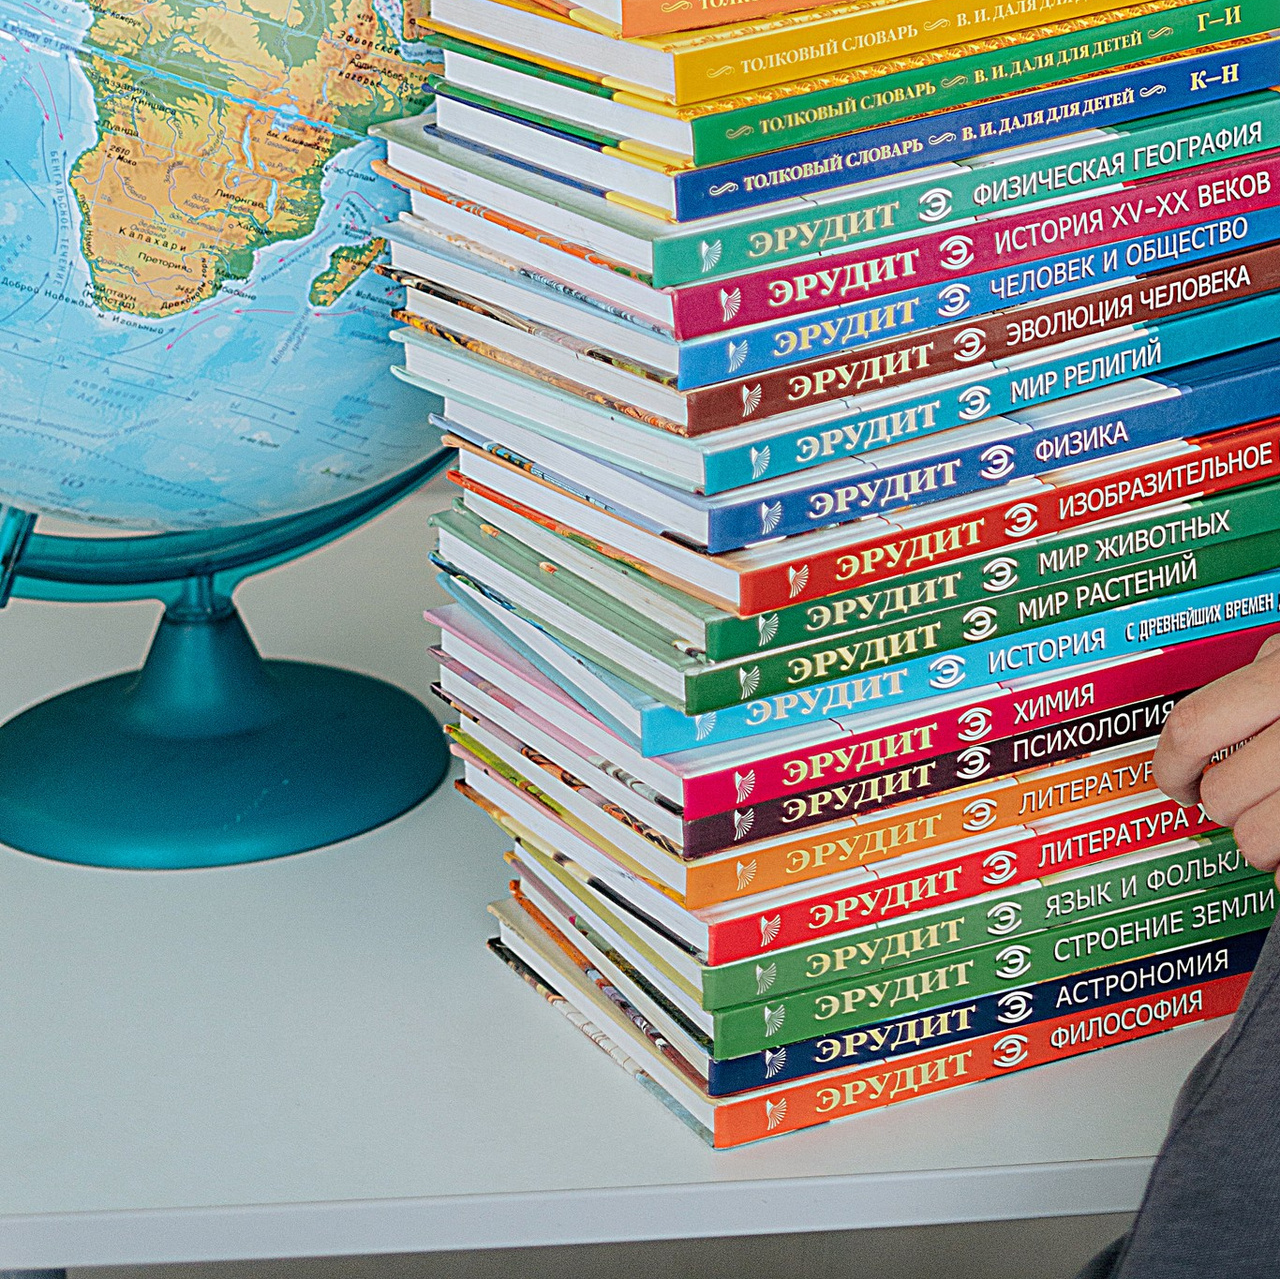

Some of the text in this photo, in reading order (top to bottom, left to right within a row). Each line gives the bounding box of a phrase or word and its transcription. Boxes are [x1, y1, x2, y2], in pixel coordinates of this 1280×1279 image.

[338, 71, 381, 88] нагорье
[741, 38, 838, 74] ТОЛКОВЫЙ
[841, 25, 918, 52] СЛОВАРЬ
[759, 97, 857, 134] ТОЛКОВЫЙ
[860, 81, 937, 110] СЛОВАРЬ
[1011, 54, 1055, 78] ДАЛЯ
[1057, 46, 1090, 66] ДЛЯ
[1092, 31, 1143, 58] ДЕТЕЙ
[102, 119, 139, 137] Луанда
[130, 94, 177, 116] Киншаса
[743, 155, 843, 191] ТОЛКОВЫЙ
[845, 139, 924, 167] СЛОВАРЬ
[998, 112, 1044, 135] ДАЛЯ
[1046, 103, 1081, 124] ДЛЯ
[1082, 88, 1135, 114] ДЕТЕЙ
[118, 227, 187, 252] Калахари
[749, 121, 1262, 257] ЭРУДИТ ФИЗИЧЕСКАЯ ГЕОГРАФИЯ
[768, 248, 919, 307] ЭРУДИТ
[995, 208, 1103, 256] ИСТОРИЯ
[1198, 171, 1271, 208] ВЕКОВ
[1, 276, 92, 309] Доброй Надежды
[53, 238, 69, 286] ТЕЧЕНИЕ
[85, 281, 138, 303] Кейптаун
[138, 252, 189, 273] Претория
[774, 217, 1248, 357] ЭРУДИТ ЧЕЛОВЕК И ОБЩЕСТВО
[113, 314, 164, 334] Игольный
[788, 263, 1251, 401] ЭРУДИТ ЭВОЛЮЦИЯ ЧЕЛОВЕКА
[795, 338, 1162, 463] ЭРУДИТ МИР РЕЛИГИЙ
[808, 420, 1128, 520] ЭРУДИТ ФИЗИКА
[835, 518, 985, 582] ЭРУДИТ
[1058, 442, 1272, 521] ИЗОБРАЗИТЕЛЬНОЕ
[787, 556, 1197, 685] ЭРУДИТ МИР РАСТЕНИЙ
[805, 509, 1231, 632] ЭРУДИТ МИР ЖИВОТНЫХ
[1125, 621, 1137, 641] С
[1139, 602, 1222, 641] ДРЕВНЕЙШИХ
[1225, 591, 1274, 620] ВРЕМЕН
[745, 627, 1106, 726] ЭРУДИТ ИСТОРИЯ
[782, 761, 936, 824] ЭРУДИТ
[1013, 700, 1175, 764] ПСИХОЛОГИЯ
[783, 683, 1095, 787] ЭРУДИТ ХИМИЯ
[785, 814, 942, 875] ЭРУДИТ
[808, 866, 962, 930] ЭРУДИТ
[1038, 807, 1189, 869] ЛИТЕРАТУРА
[805, 917, 965, 979] ЭРУДИТ
[1045, 882, 1111, 919] ЯЗЫК
[1121, 876, 1137, 900] И
[814, 889, 1275, 1021] ЭРУДИТ СТРОЕНИЕ ЗЕМЛИ
[814, 949, 1229, 1063] ЭРУДИТ АСТРОНОМИЯ
[815, 989, 1203, 1114] ЭРУДИТ ФИЛОСОФИЯ
